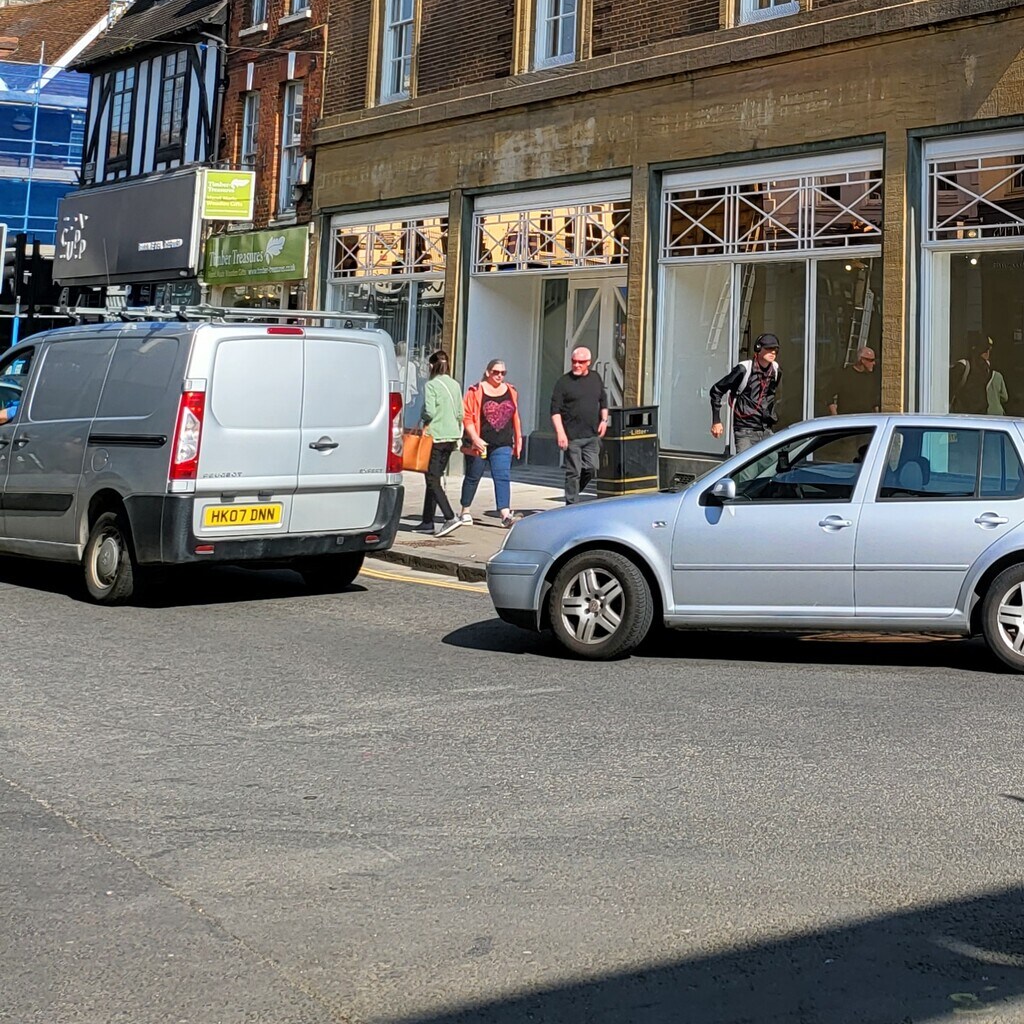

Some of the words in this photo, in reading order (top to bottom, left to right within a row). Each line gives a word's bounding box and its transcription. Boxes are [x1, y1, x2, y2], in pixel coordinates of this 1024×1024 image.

[209, 249, 231, 267] Timber
[232, 249, 263, 265] Treasures
[203, 471, 243, 479] PEUGEOT
[211, 509, 247, 524] HK07
[250, 507, 275, 521] DNN
